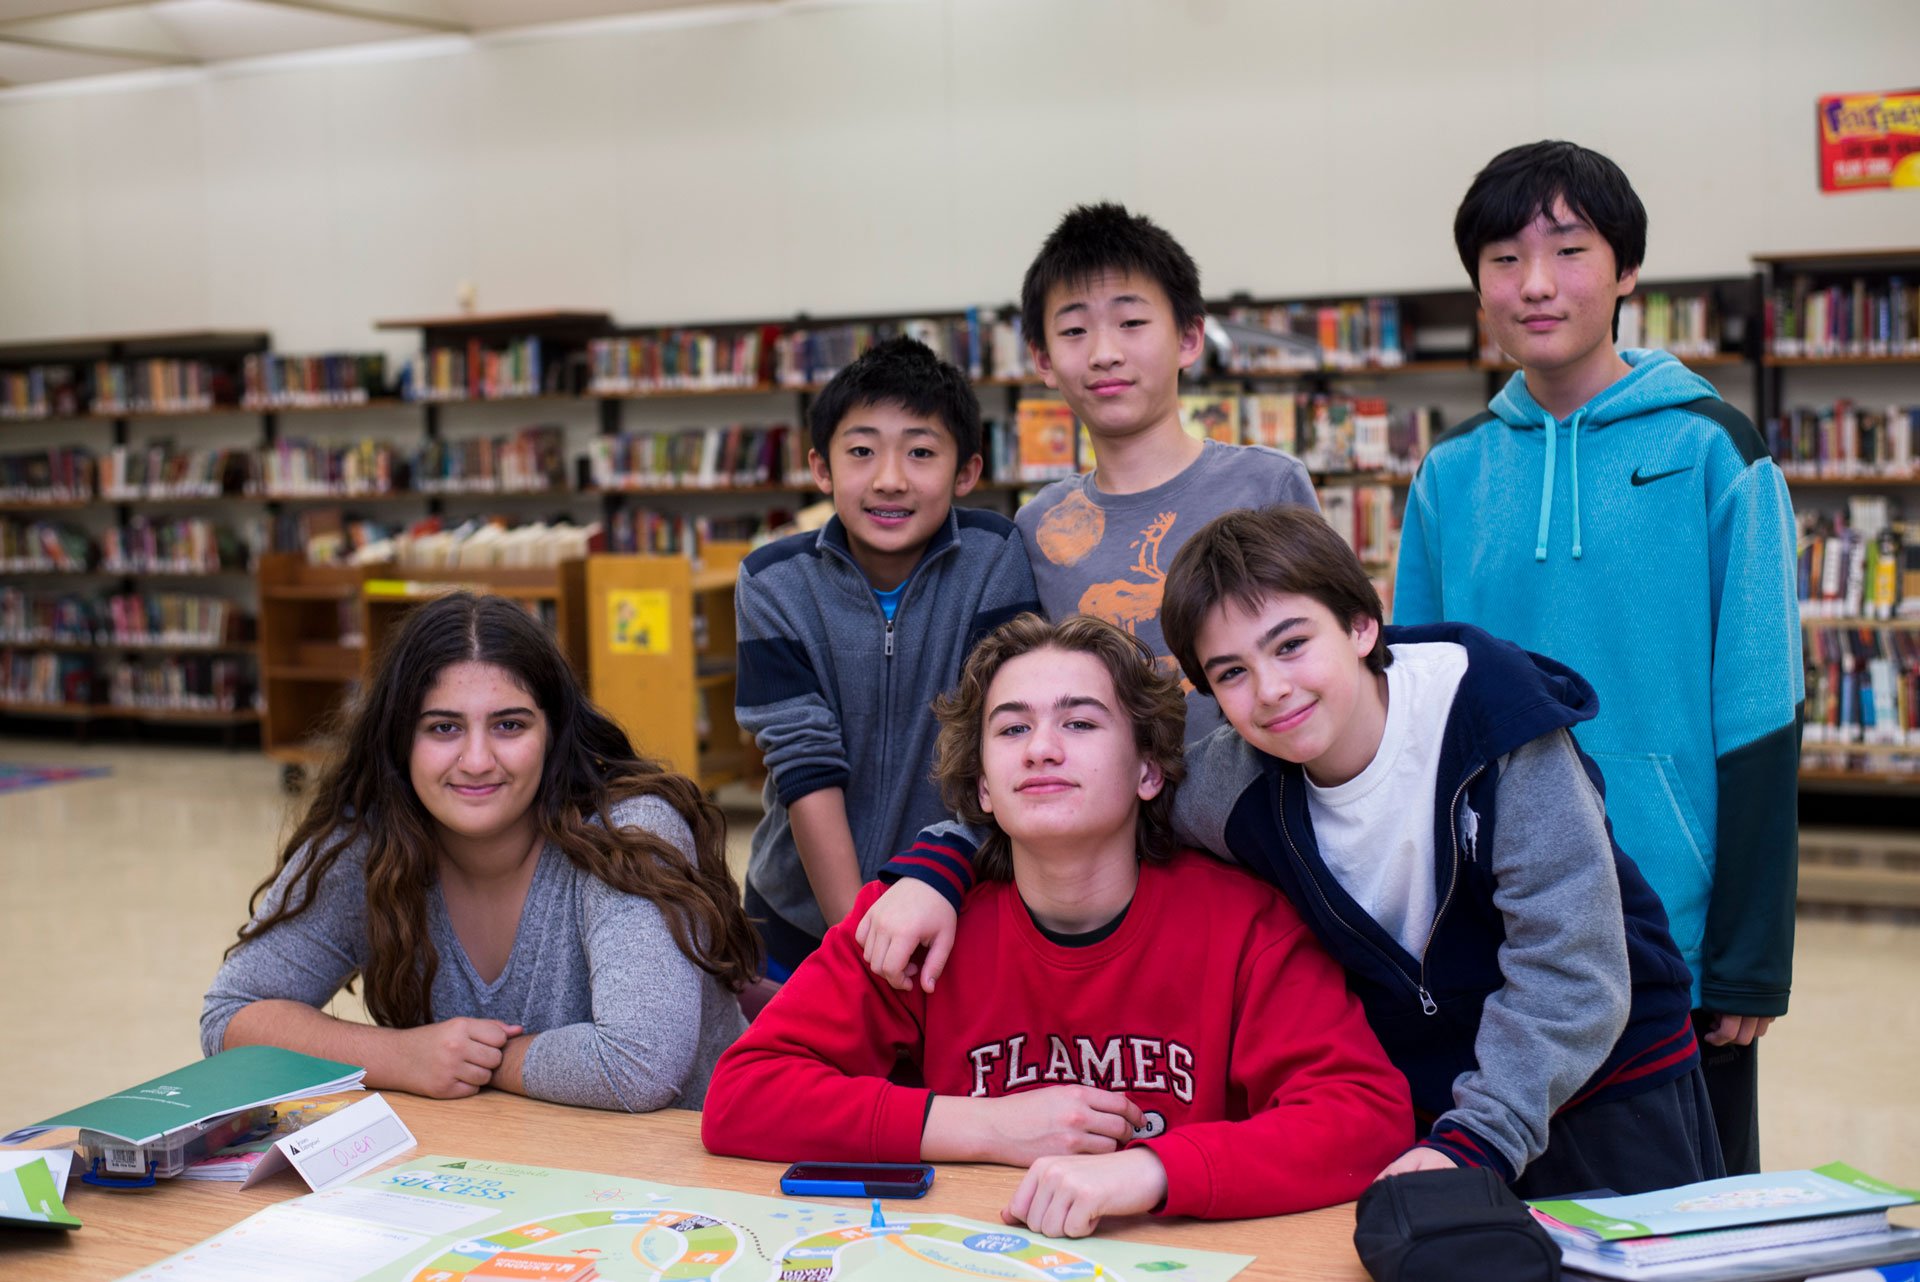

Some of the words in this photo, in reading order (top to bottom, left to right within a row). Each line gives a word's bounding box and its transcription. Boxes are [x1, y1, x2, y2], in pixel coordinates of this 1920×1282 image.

[968, 1034, 1195, 1104] FLAMES
[332, 1136, 377, 1167] Owen
[381, 1175, 516, 1200] SUCCESS
[975, 1239, 1015, 1251] KEY
